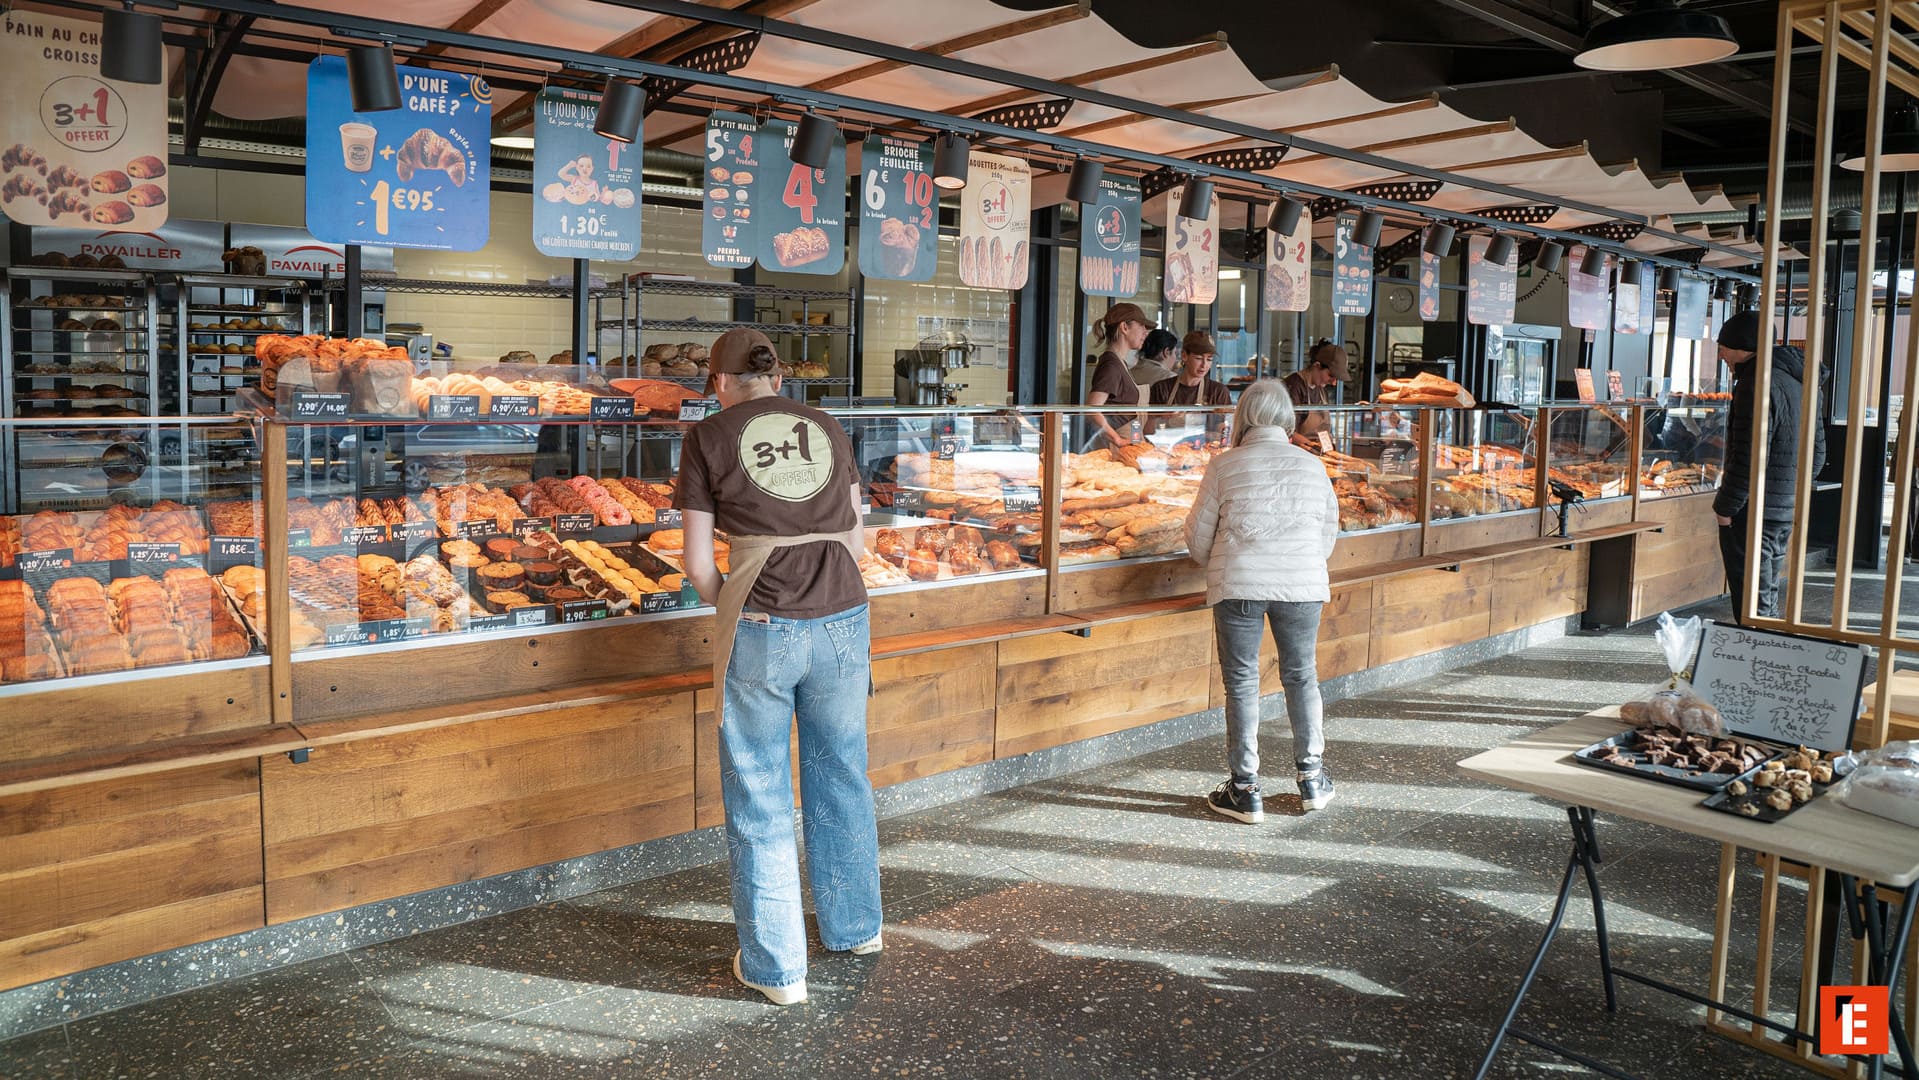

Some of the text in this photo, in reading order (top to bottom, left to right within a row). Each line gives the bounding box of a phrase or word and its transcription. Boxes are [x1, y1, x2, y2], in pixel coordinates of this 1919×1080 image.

[5, 21, 103, 45] PAIN AU CH
[43, 48, 98, 65] CROISS
[404, 75, 449, 94] D'UNE
[408, 96, 446, 114] CAFÉ
[543, 100, 595, 121] LE JOUR DES
[711, 119, 757, 132] LE P'TIT MALIN
[65, 130, 110, 142] OFFERT
[738, 134, 753, 159] 4
[884, 146, 919, 160] BRIOCHE
[879, 157, 924, 171] FEUILLETÉE
[969, 159, 998, 170] AGUETTES
[902, 170, 934, 208] 10
[370, 180, 434, 235] 1€95
[560, 214, 607, 236] 1,30€
[919, 206, 933, 230] 2
[987, 215, 1006, 224] OFFERT
[1201, 228, 1213, 253] 2
[80, 243, 181, 260] PAVAILLER
[707, 253, 725, 262] C'QUE
[726, 254, 735, 262] TU
[717, 247, 740, 255] PRENDS
[1296, 241, 1306, 263] 2
[271, 260, 345, 272] PAVAILLE
[752, 421, 812, 468] 3+1
[771, 467, 817, 487] OFFERT
[1712, 647, 1841, 681] Grand fondant Chocolat
